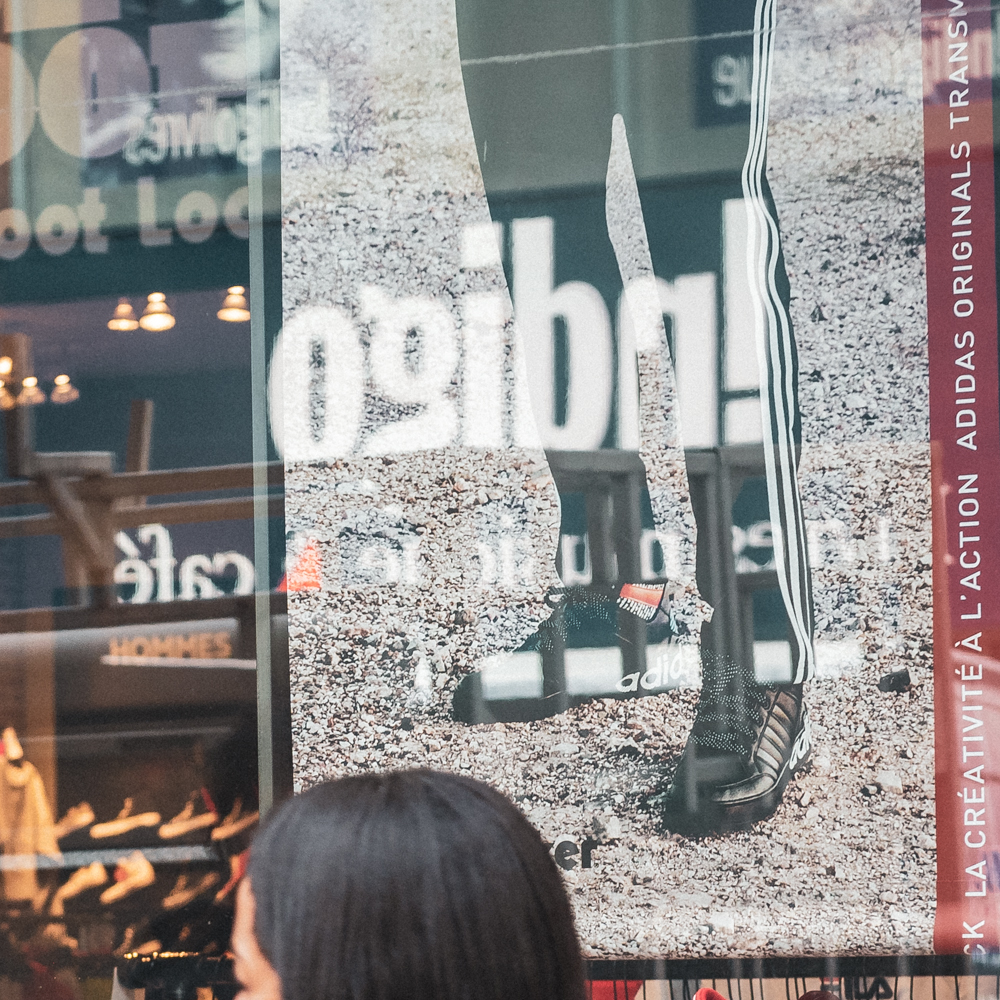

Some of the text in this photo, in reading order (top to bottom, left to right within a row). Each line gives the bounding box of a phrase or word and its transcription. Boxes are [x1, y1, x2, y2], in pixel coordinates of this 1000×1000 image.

[951, 140, 974, 318] ORIGINALS
[954, 330, 977, 451] ADIDAS
[957, 473, 983, 620] L'ACTION
[108, 631, 233, 659] HOMMES
[954, 631, 983, 653] À
[955, 663, 986, 849] CRÉATIVITÉ
[964, 858, 987, 897] LA
